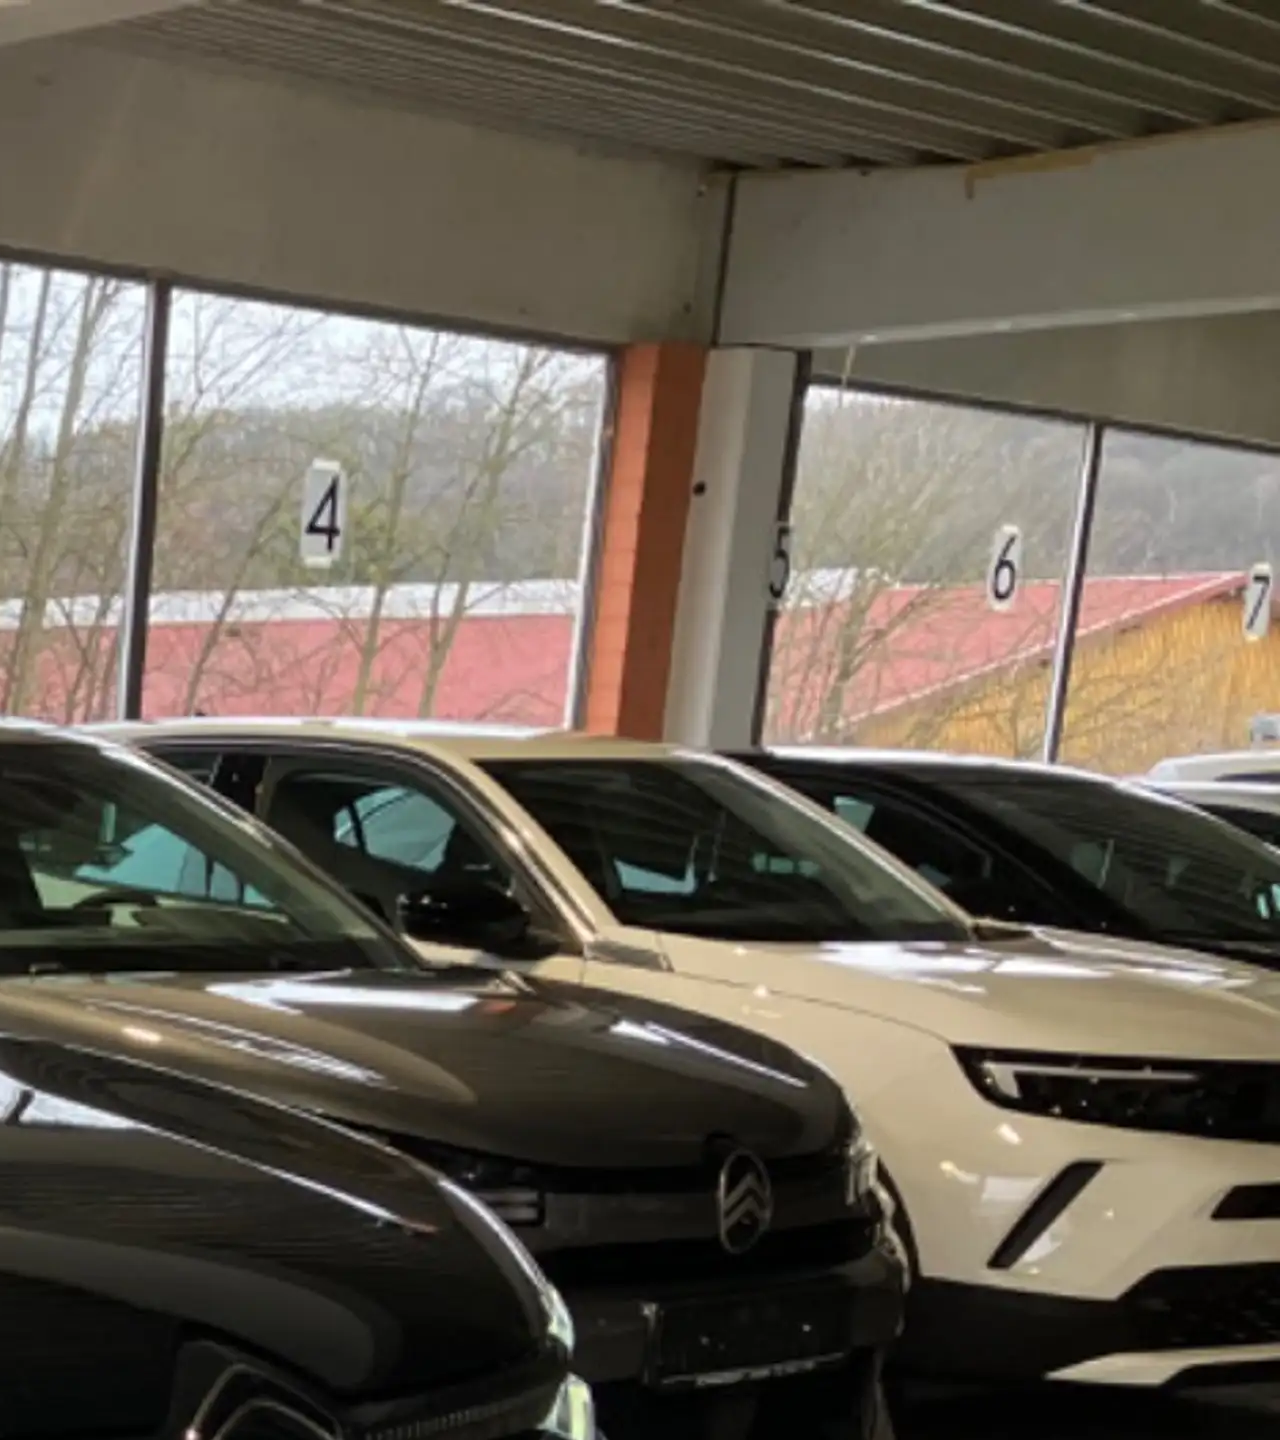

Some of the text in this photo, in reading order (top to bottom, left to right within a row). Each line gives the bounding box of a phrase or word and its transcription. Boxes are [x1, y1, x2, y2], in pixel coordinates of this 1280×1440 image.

[305, 474, 340, 553] 4
[993, 534, 1016, 602] 6
[1245, 573, 1270, 631] 7
